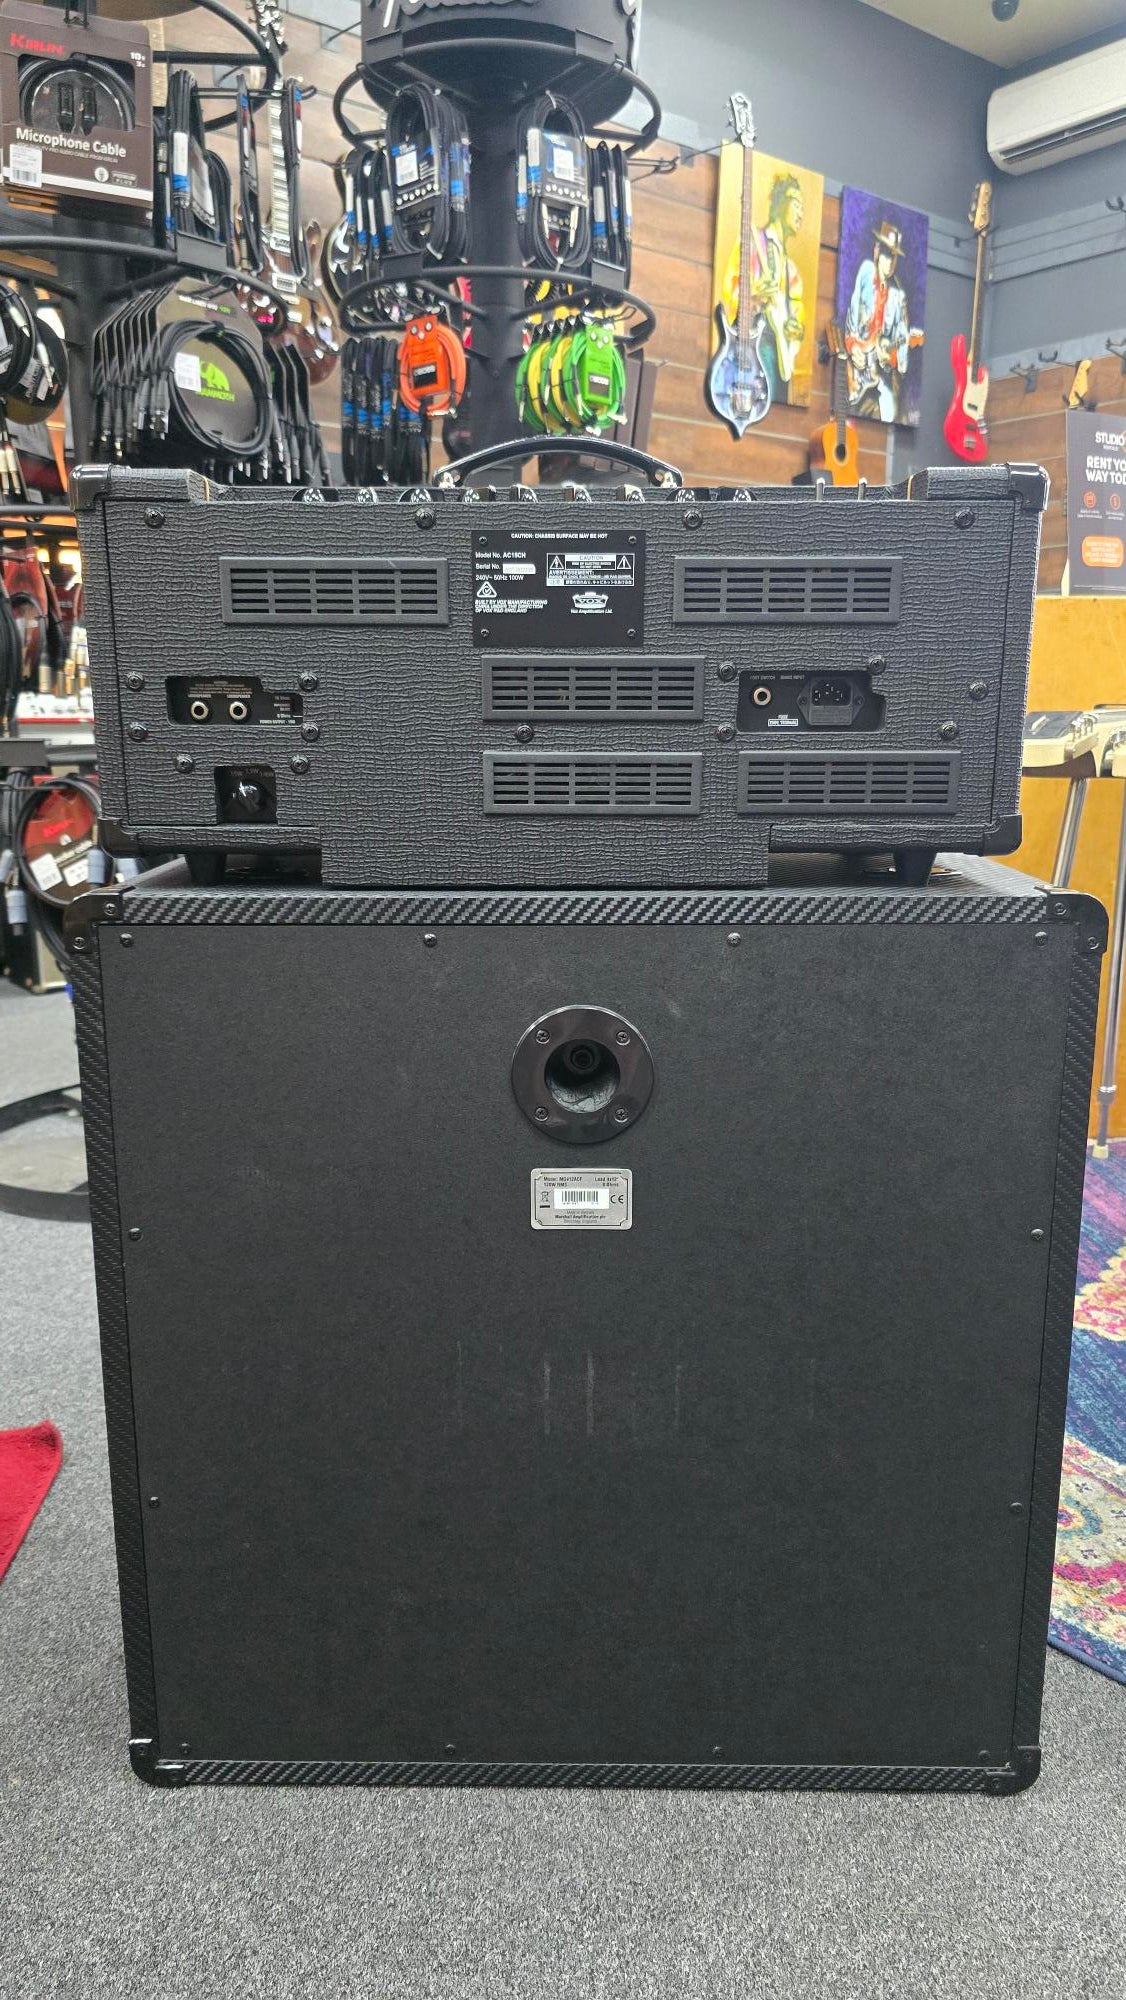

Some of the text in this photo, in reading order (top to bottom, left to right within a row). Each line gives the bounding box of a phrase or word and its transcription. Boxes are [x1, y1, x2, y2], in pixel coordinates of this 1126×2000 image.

[16, 127, 127, 158] Microphone Cable
[1095, 431, 1125, 446] STUDIO
[1086, 455, 1112, 470] RENT
[1085, 469, 1108, 482] WAY
